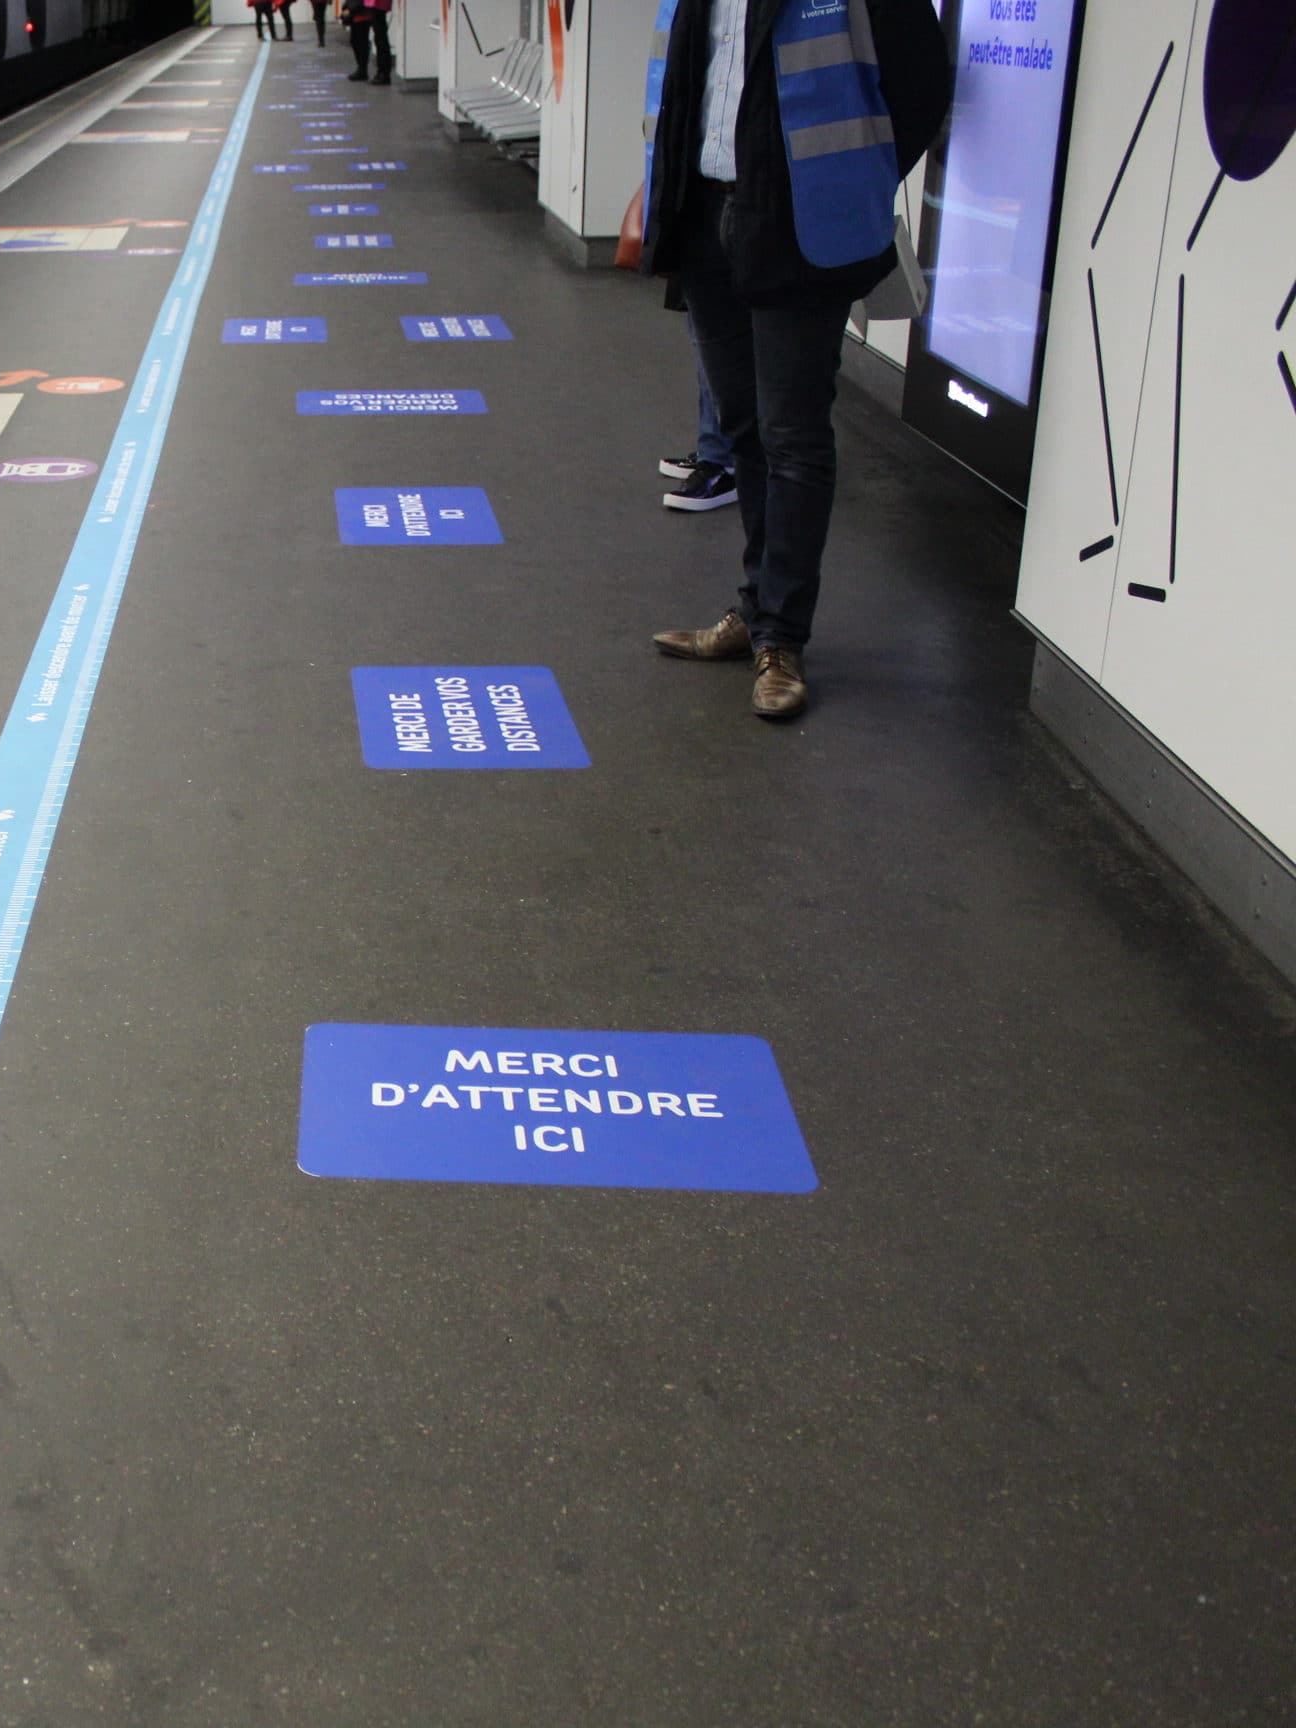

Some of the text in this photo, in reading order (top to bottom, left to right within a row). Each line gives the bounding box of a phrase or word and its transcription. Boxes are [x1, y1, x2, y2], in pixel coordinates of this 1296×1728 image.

[990, 0, 1012, 20] Vous
[968, 36, 1053, 70] peut-être malade
[389, 693, 433, 752] MERCI DE
[434, 677, 487, 752] GARDER VOS
[486, 684, 541, 752] DISTANCES
[444, 1049, 619, 1078] MERCI
[371, 1082, 725, 1118] D'ATTENDRE
[514, 1124, 585, 1153] ICI
